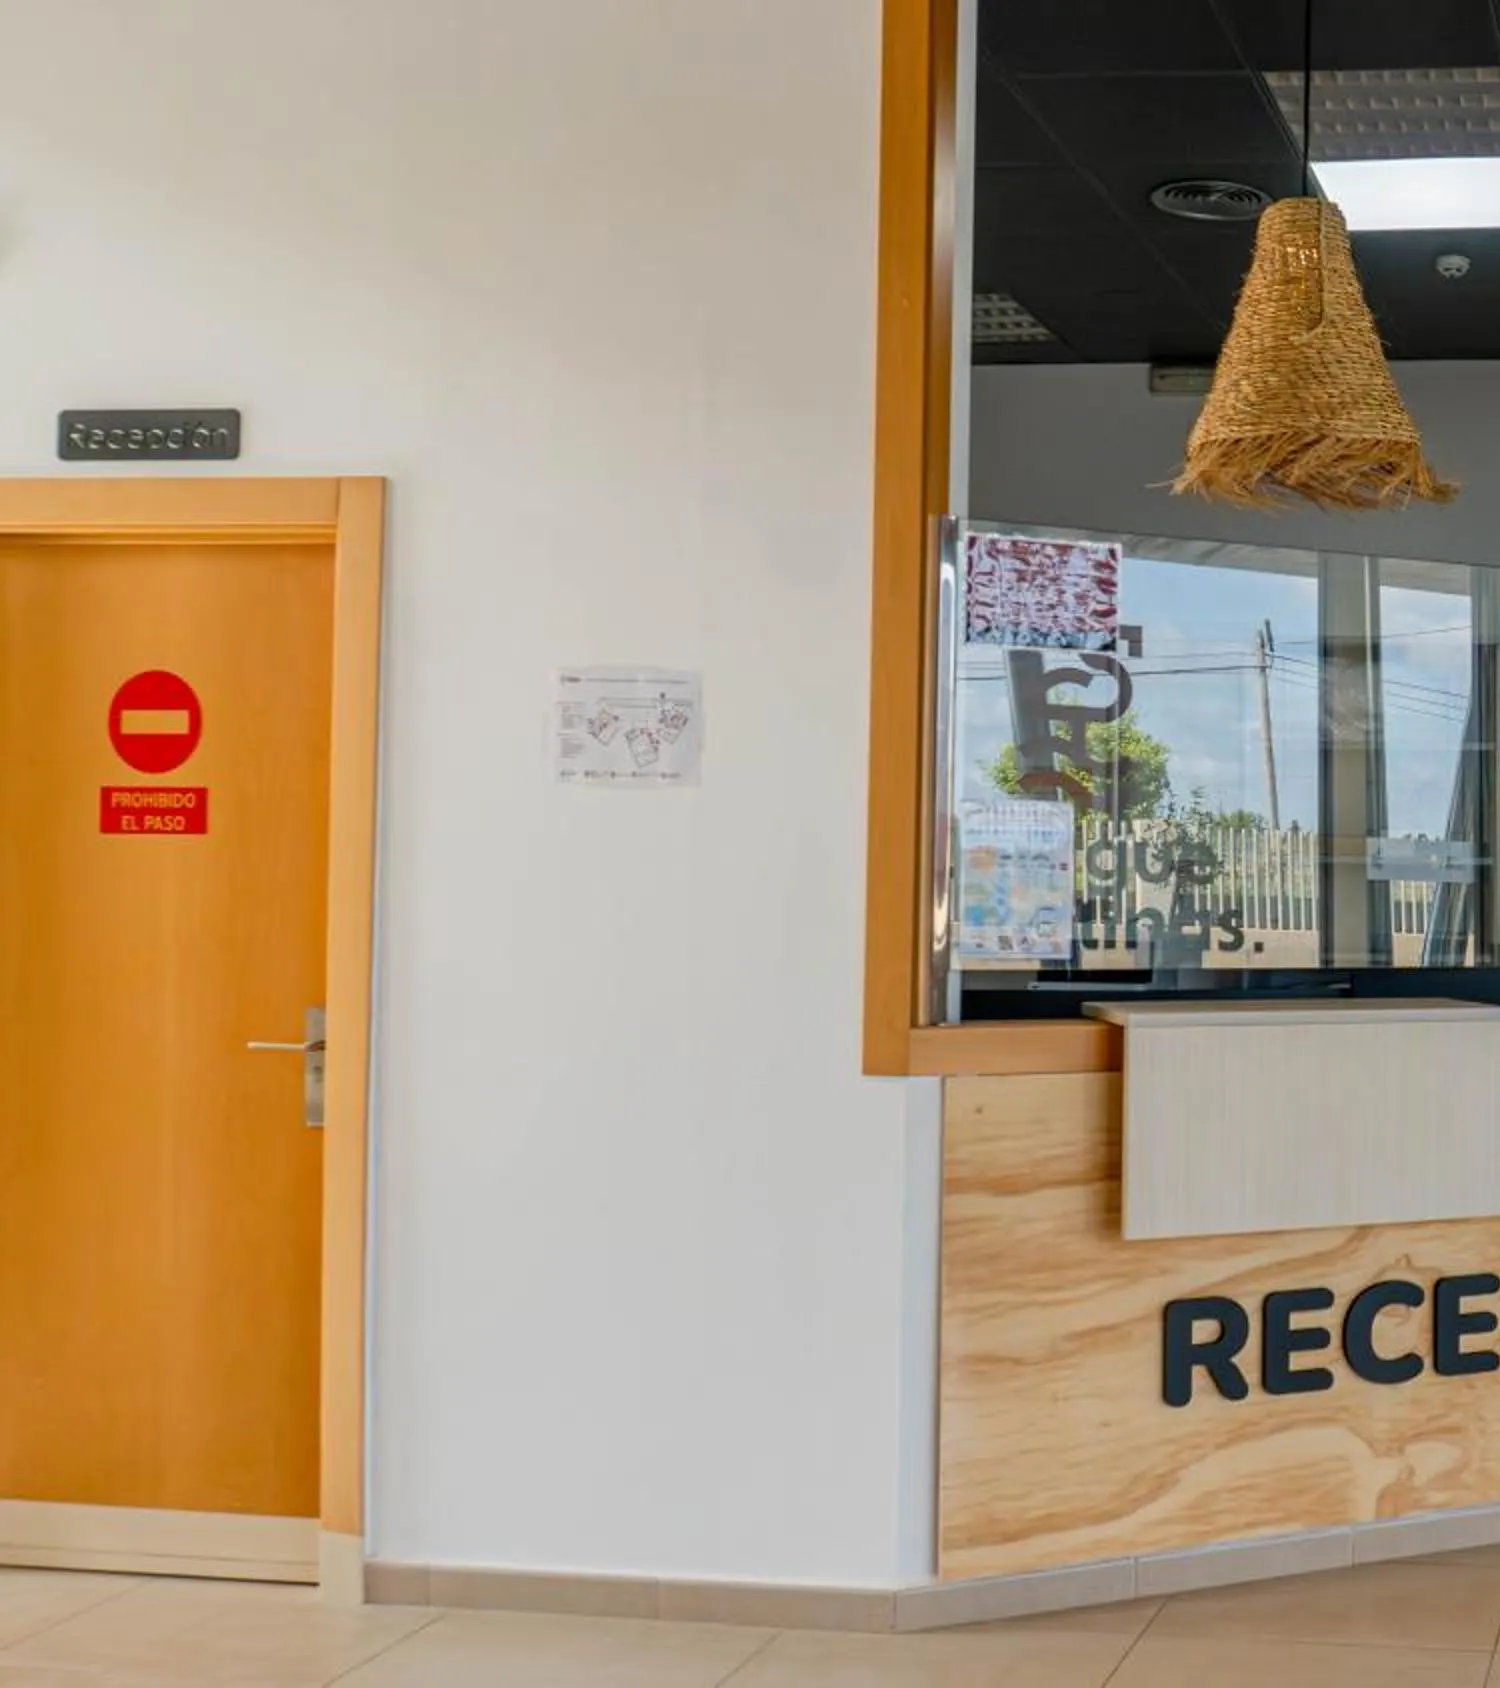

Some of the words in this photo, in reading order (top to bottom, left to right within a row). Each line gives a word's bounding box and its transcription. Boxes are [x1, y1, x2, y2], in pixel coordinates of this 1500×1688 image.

[67, 421, 229, 453] Recepción
[111, 791, 196, 808] PROHIBIDO
[121, 815, 139, 831] EL
[143, 815, 186, 831] PASO
[1086, 838, 1219, 893] que
